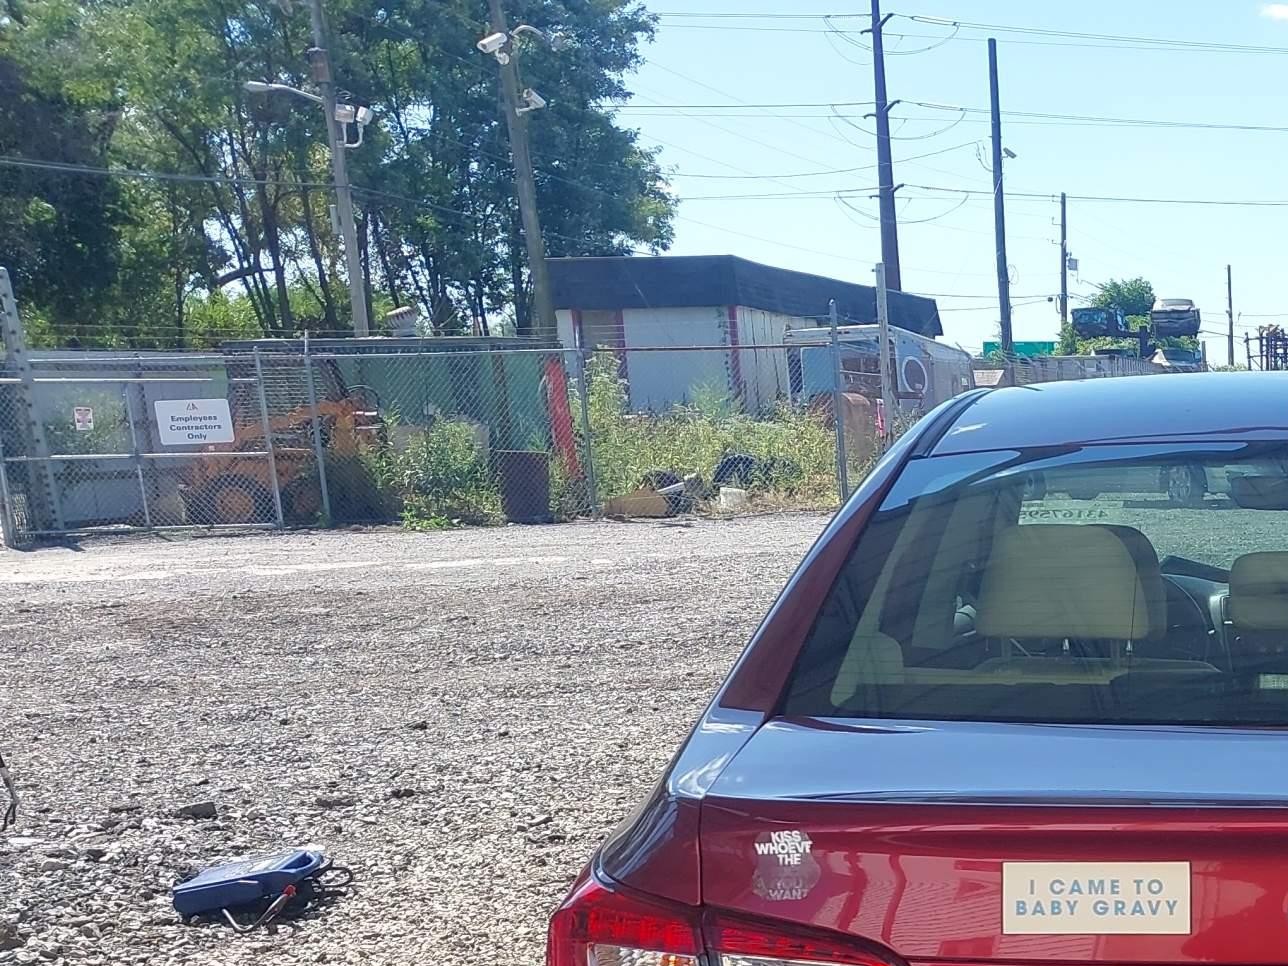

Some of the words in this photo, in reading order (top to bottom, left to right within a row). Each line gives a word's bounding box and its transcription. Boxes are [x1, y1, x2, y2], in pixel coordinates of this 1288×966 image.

[170, 415, 218, 423] Employees
[187, 432, 207, 441] Only
[770, 830, 801, 843] KISS
[777, 854, 801, 865] THE
[1029, 879, 1035, 895] I
[1050, 879, 1121, 895] CAME
[1133, 879, 1164, 895] TO
[768, 888, 808, 900] WANT
[1015, 900, 1078, 916] BABY
[1093, 900, 1178, 916] GRAVY
